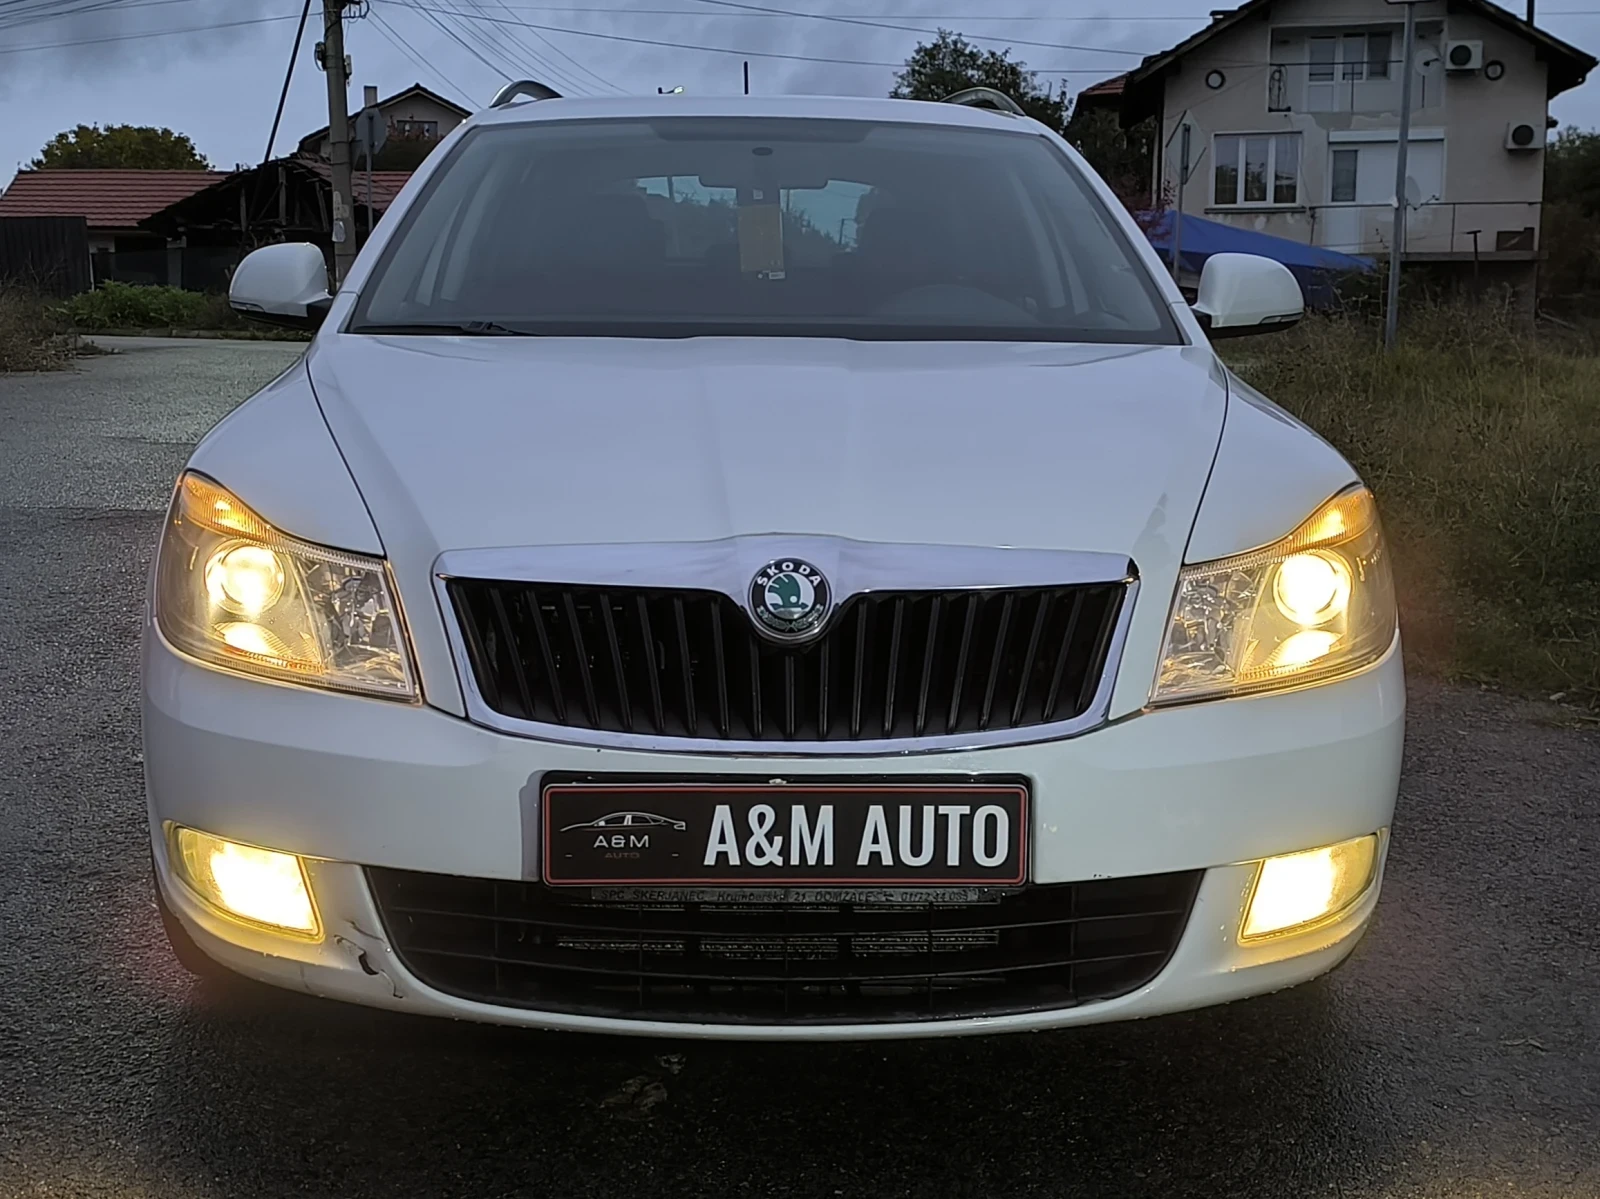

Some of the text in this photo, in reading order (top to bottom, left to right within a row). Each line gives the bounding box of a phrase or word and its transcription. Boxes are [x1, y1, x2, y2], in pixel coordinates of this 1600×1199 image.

[757, 561, 822, 587] SKODA
[593, 834, 650, 849] A&M
[703, 804, 1010, 867] A&M AUTO
[604, 852, 640, 860] AUTO
